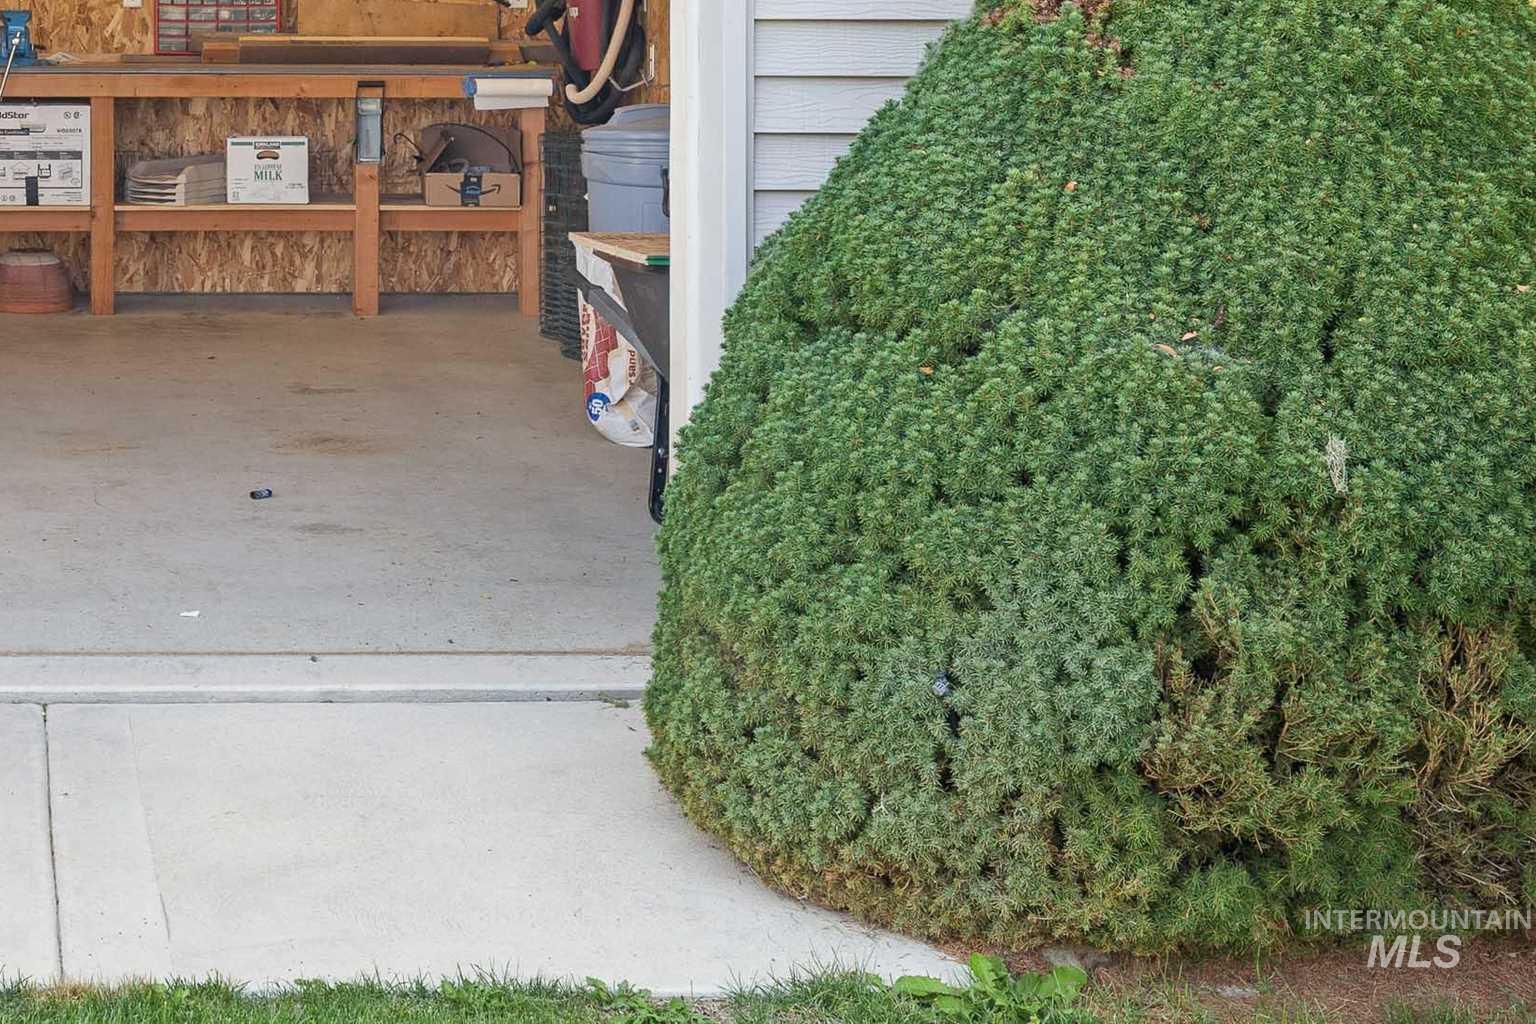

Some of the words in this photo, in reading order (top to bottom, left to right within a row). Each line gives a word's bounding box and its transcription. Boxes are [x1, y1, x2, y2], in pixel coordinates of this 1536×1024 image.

[254, 170, 283, 181] MILK
[628, 349, 636, 378] sand
[591, 398, 604, 415] 50
